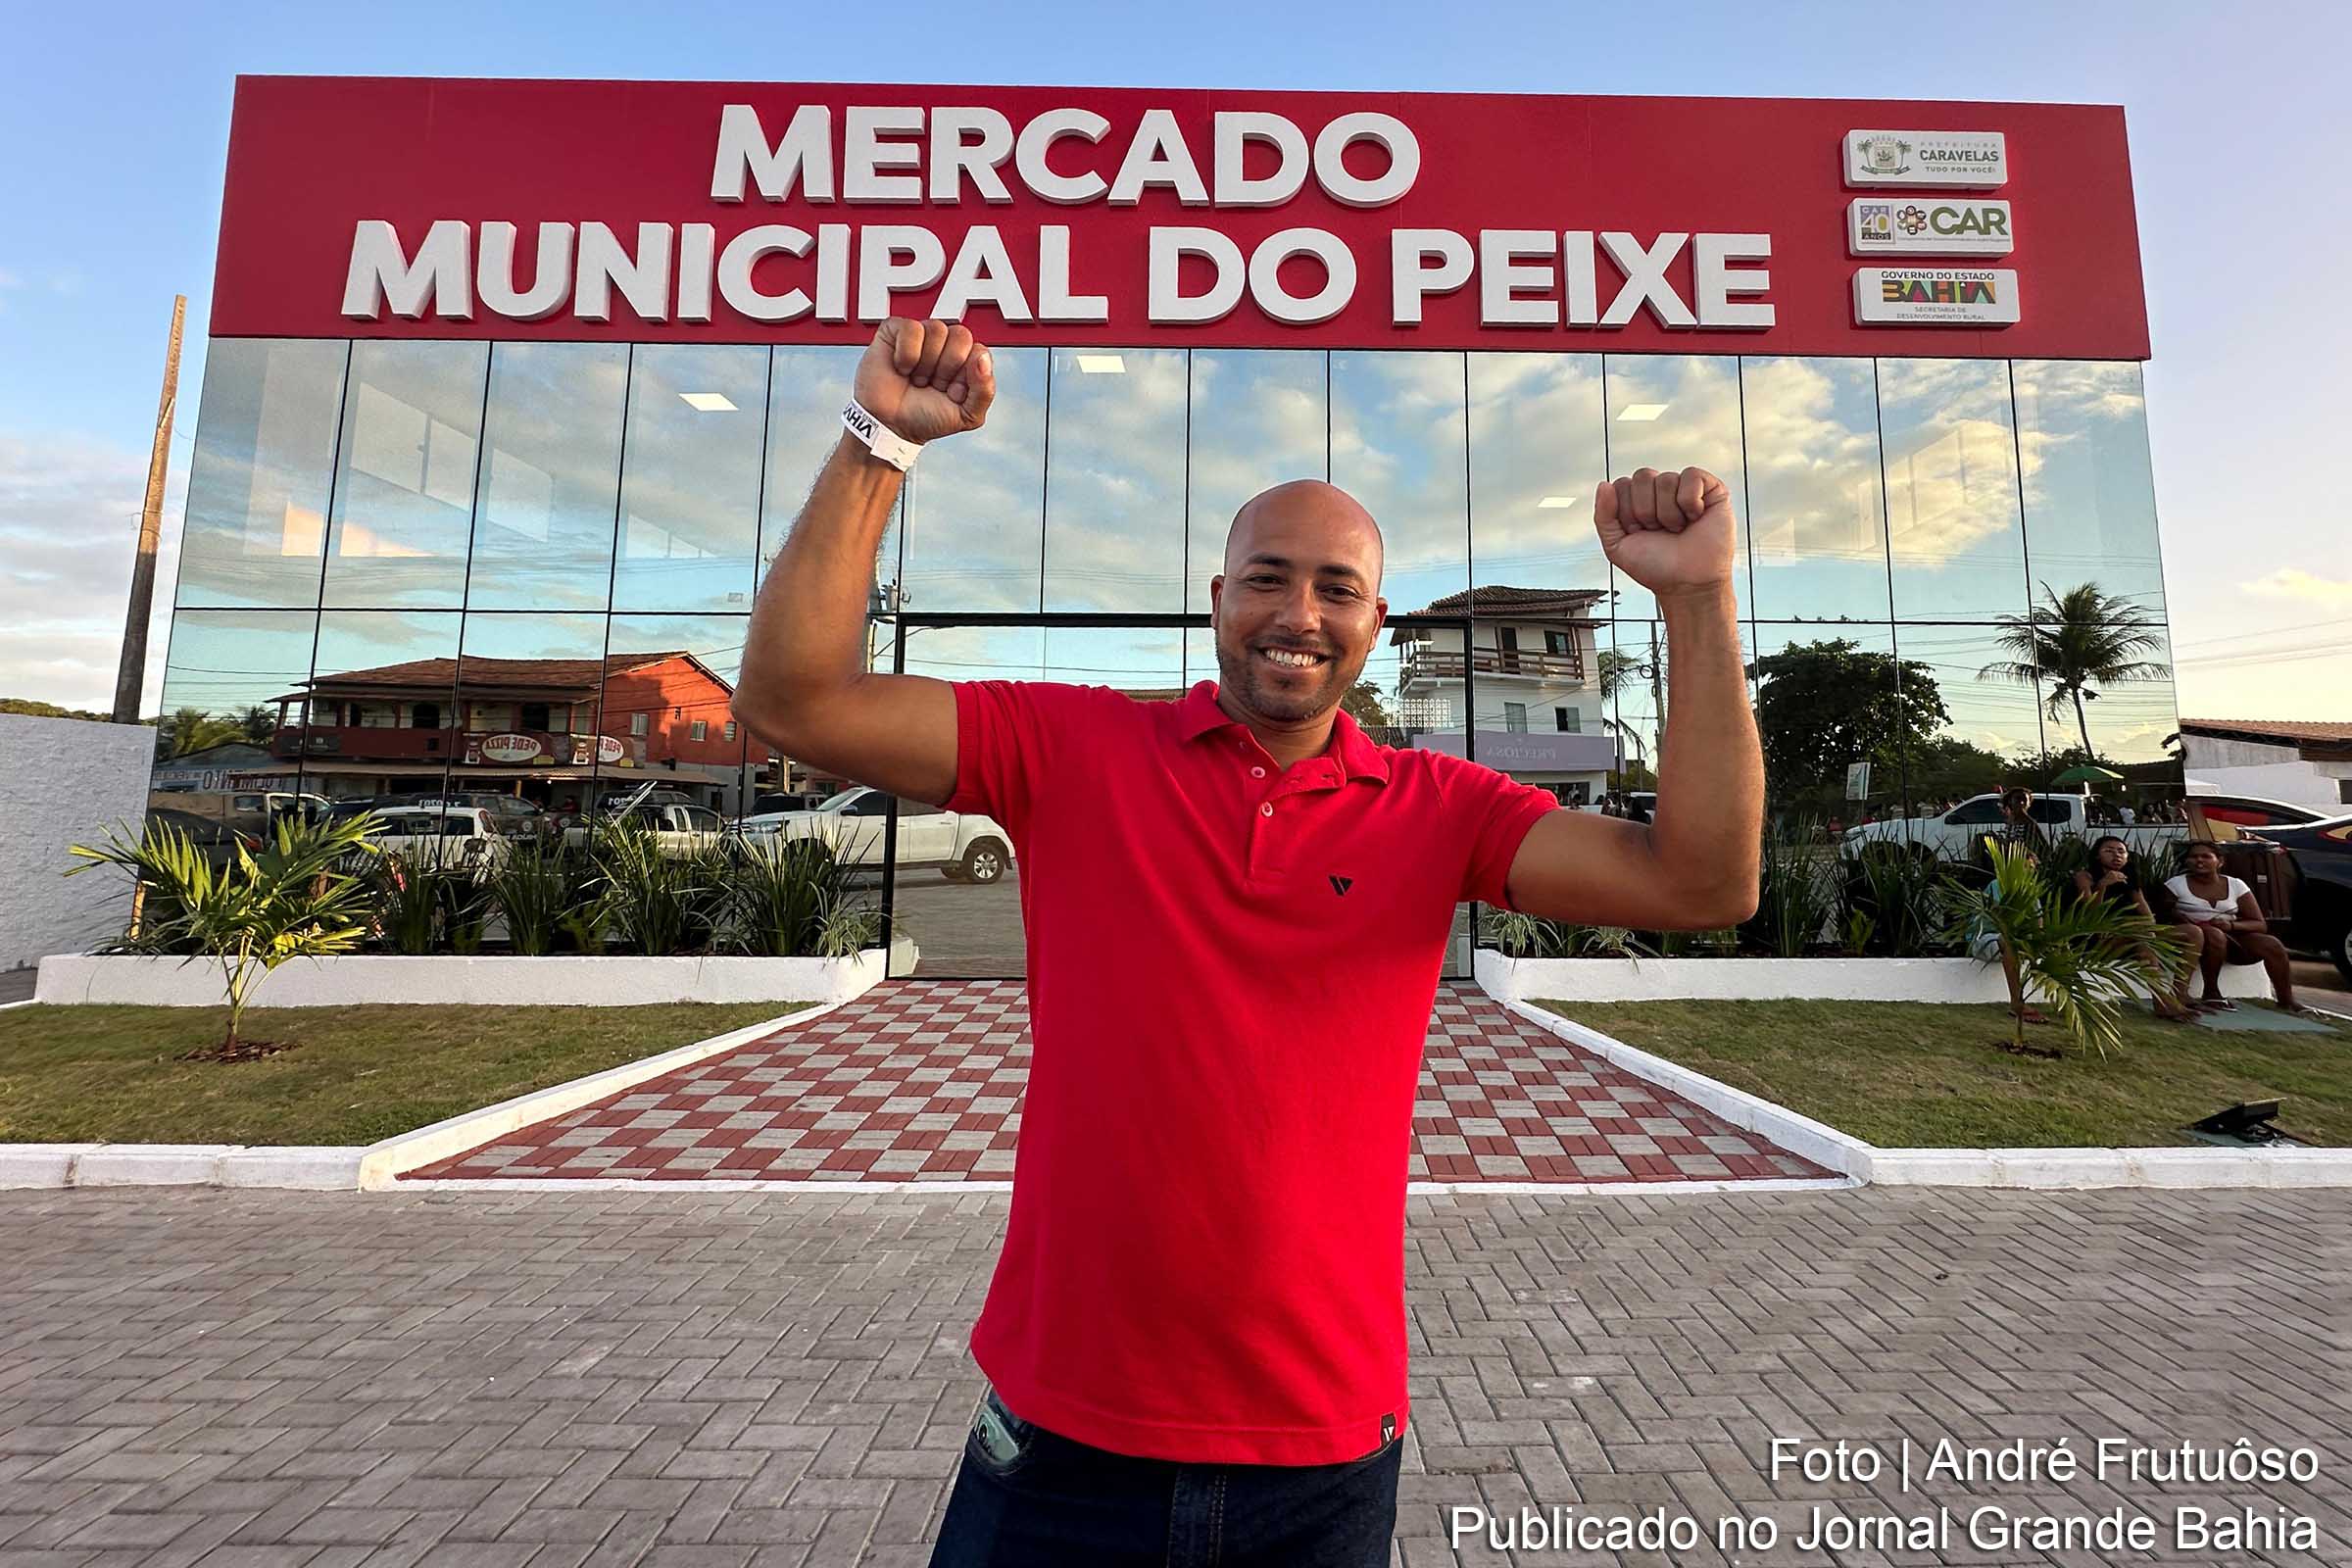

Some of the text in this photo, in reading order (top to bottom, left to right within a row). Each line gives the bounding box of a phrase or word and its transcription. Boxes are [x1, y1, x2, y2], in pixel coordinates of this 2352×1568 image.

[710, 104, 1420, 207] MERCADO
[1920, 150, 1999, 162] CARAVELAS
[1862, 214, 1889, 234] 40
[1930, 206, 2008, 235] CAR
[341, 220, 1776, 328] MUNICIPAL DO PEIXE
[1882, 270, 1934, 279] GOVERNO
[1936, 271, 1951, 280] DO
[1882, 280, 1996, 304] BAHIA
